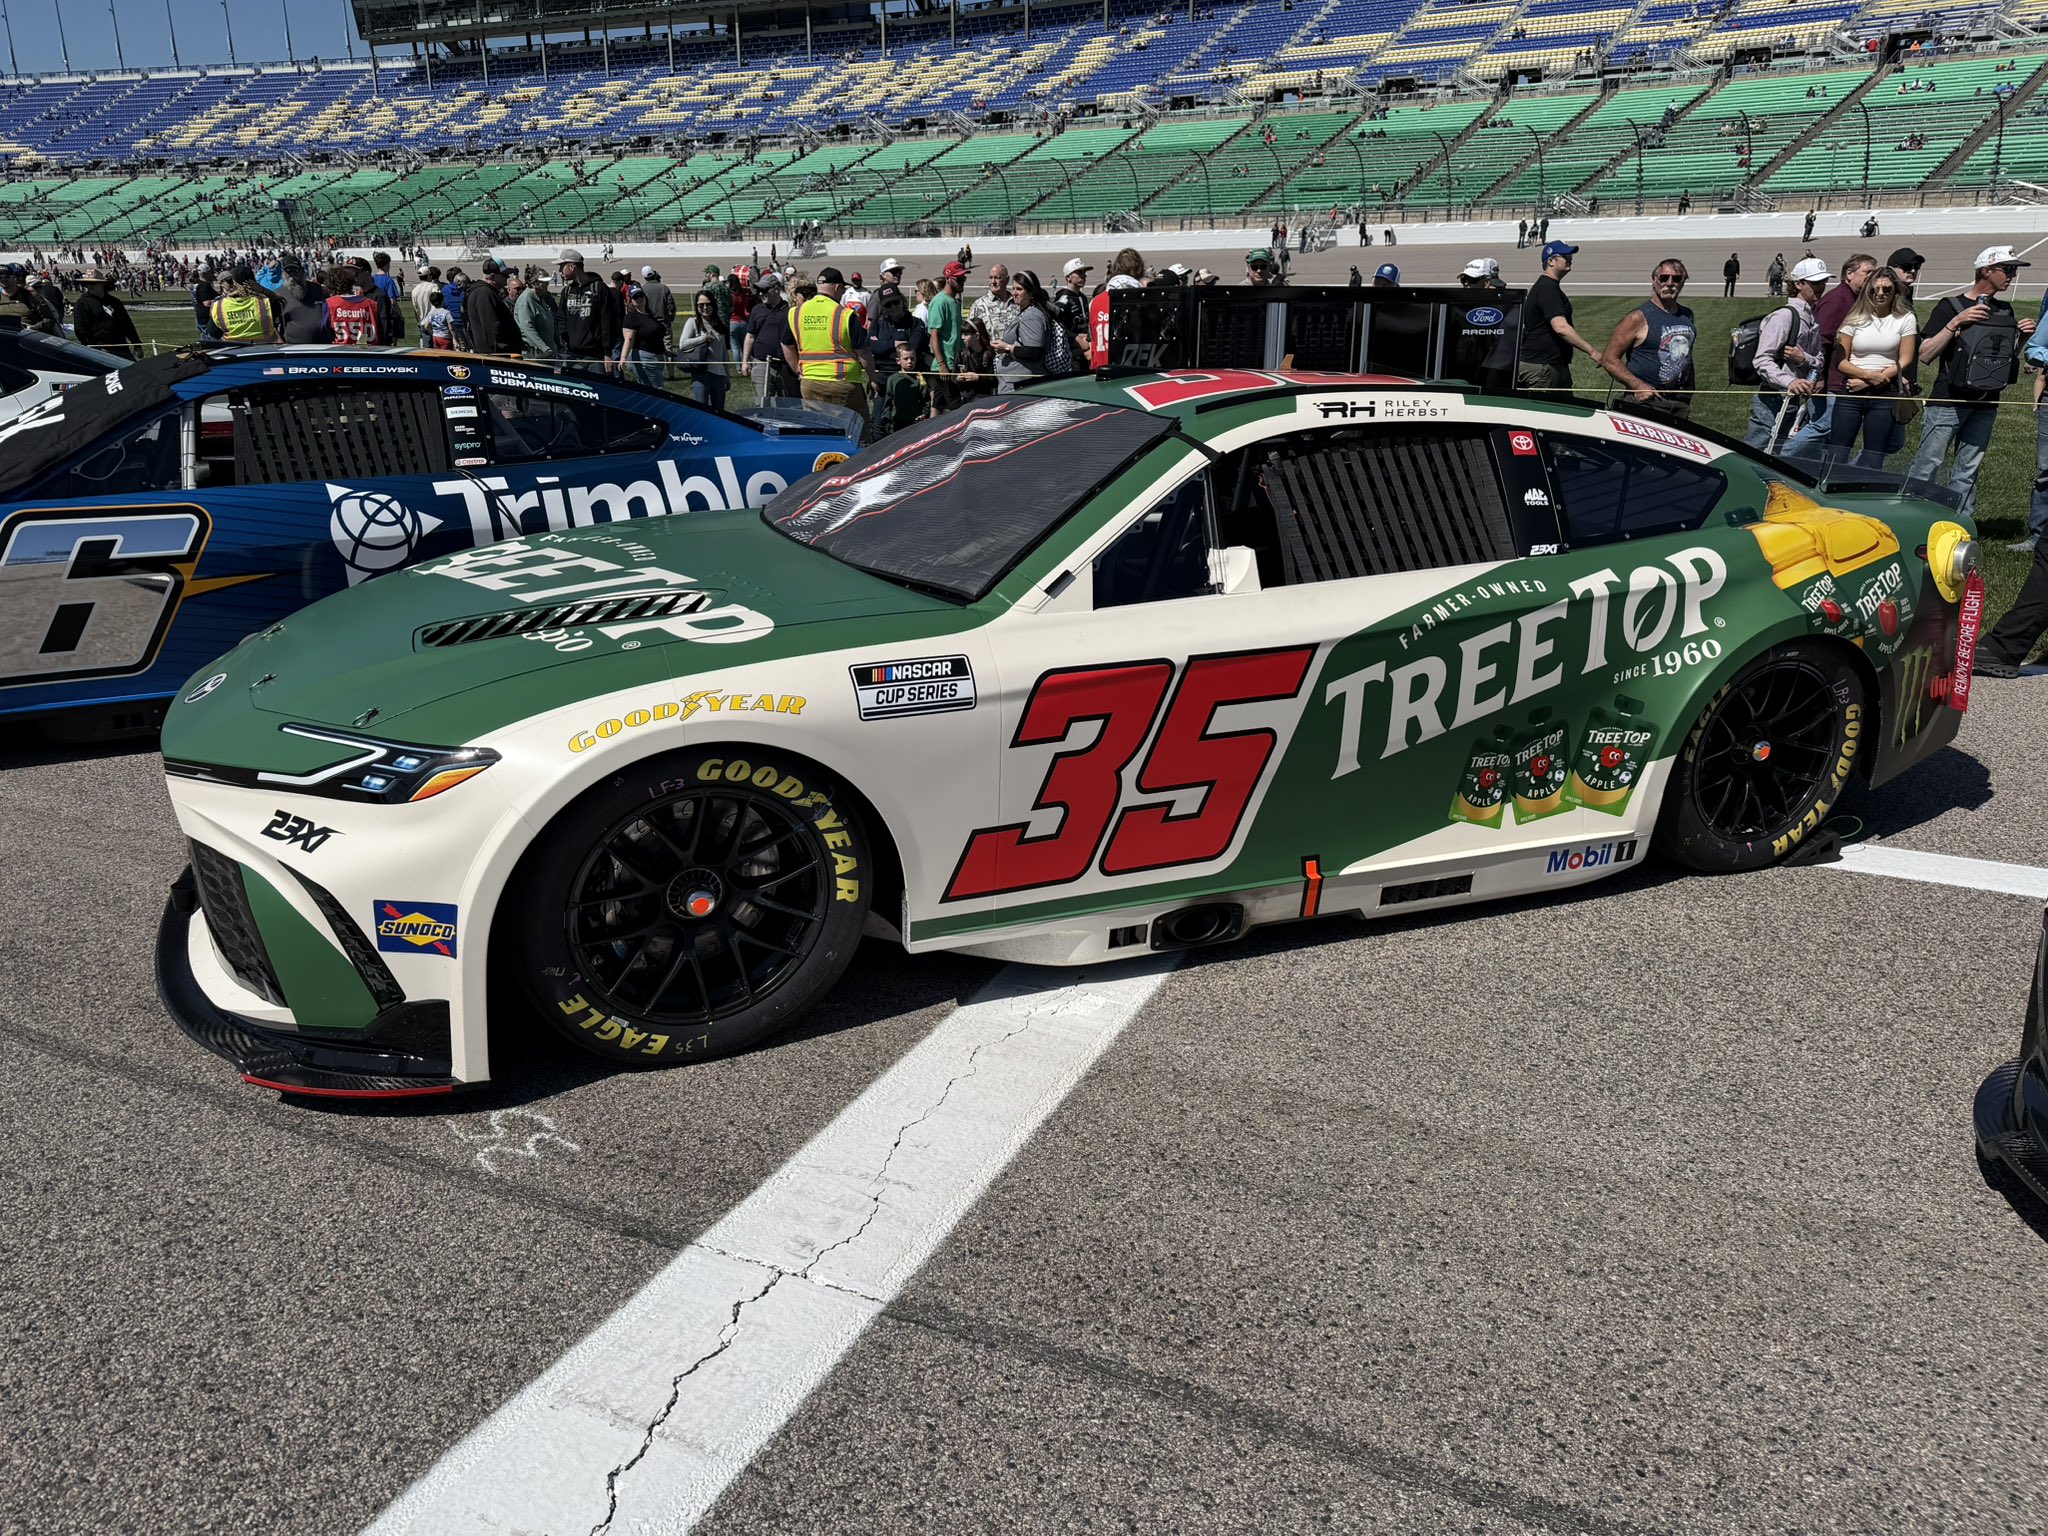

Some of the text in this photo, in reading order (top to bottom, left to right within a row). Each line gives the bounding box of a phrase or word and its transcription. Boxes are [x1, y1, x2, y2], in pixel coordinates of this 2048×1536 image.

[227, 309, 257, 321] SECURITY
[336, 307, 371, 321] Security
[803, 315, 829, 324] SECURITY
[1472, 308, 1497, 323] Ford
[1462, 328, 1505, 336] RACING
[288, 366, 418, 374] BRAD KESELOWSKI
[490, 368, 527, 380] BUILD
[491, 376, 600, 400] SUBMARINES.COM
[1385, 408, 1449, 417] HERBST
[1613, 417, 1708, 456] TERRIBLE'S
[1524, 487, 1549, 501] MAC
[0, 506, 208, 686] 6
[1398, 578, 1549, 651] FARMER-OWNED
[1953, 589, 1982, 697] REMOVE BEFORE FLIGHT
[1613, 638, 1722, 685] SINCE 1960
[892, 661, 952, 681] NASCAR
[875, 682, 959, 706] CUP SERIES
[939, 642, 1321, 904] 35
[1527, 782, 1557, 798] APPLE
[1584, 774, 1616, 790] APPLE
[1467, 793, 1491, 806] APPLE
[1546, 842, 1613, 873] Mobil
[381, 920, 456, 939] SUNOCO
[558, 993, 670, 1055] EAGLE
